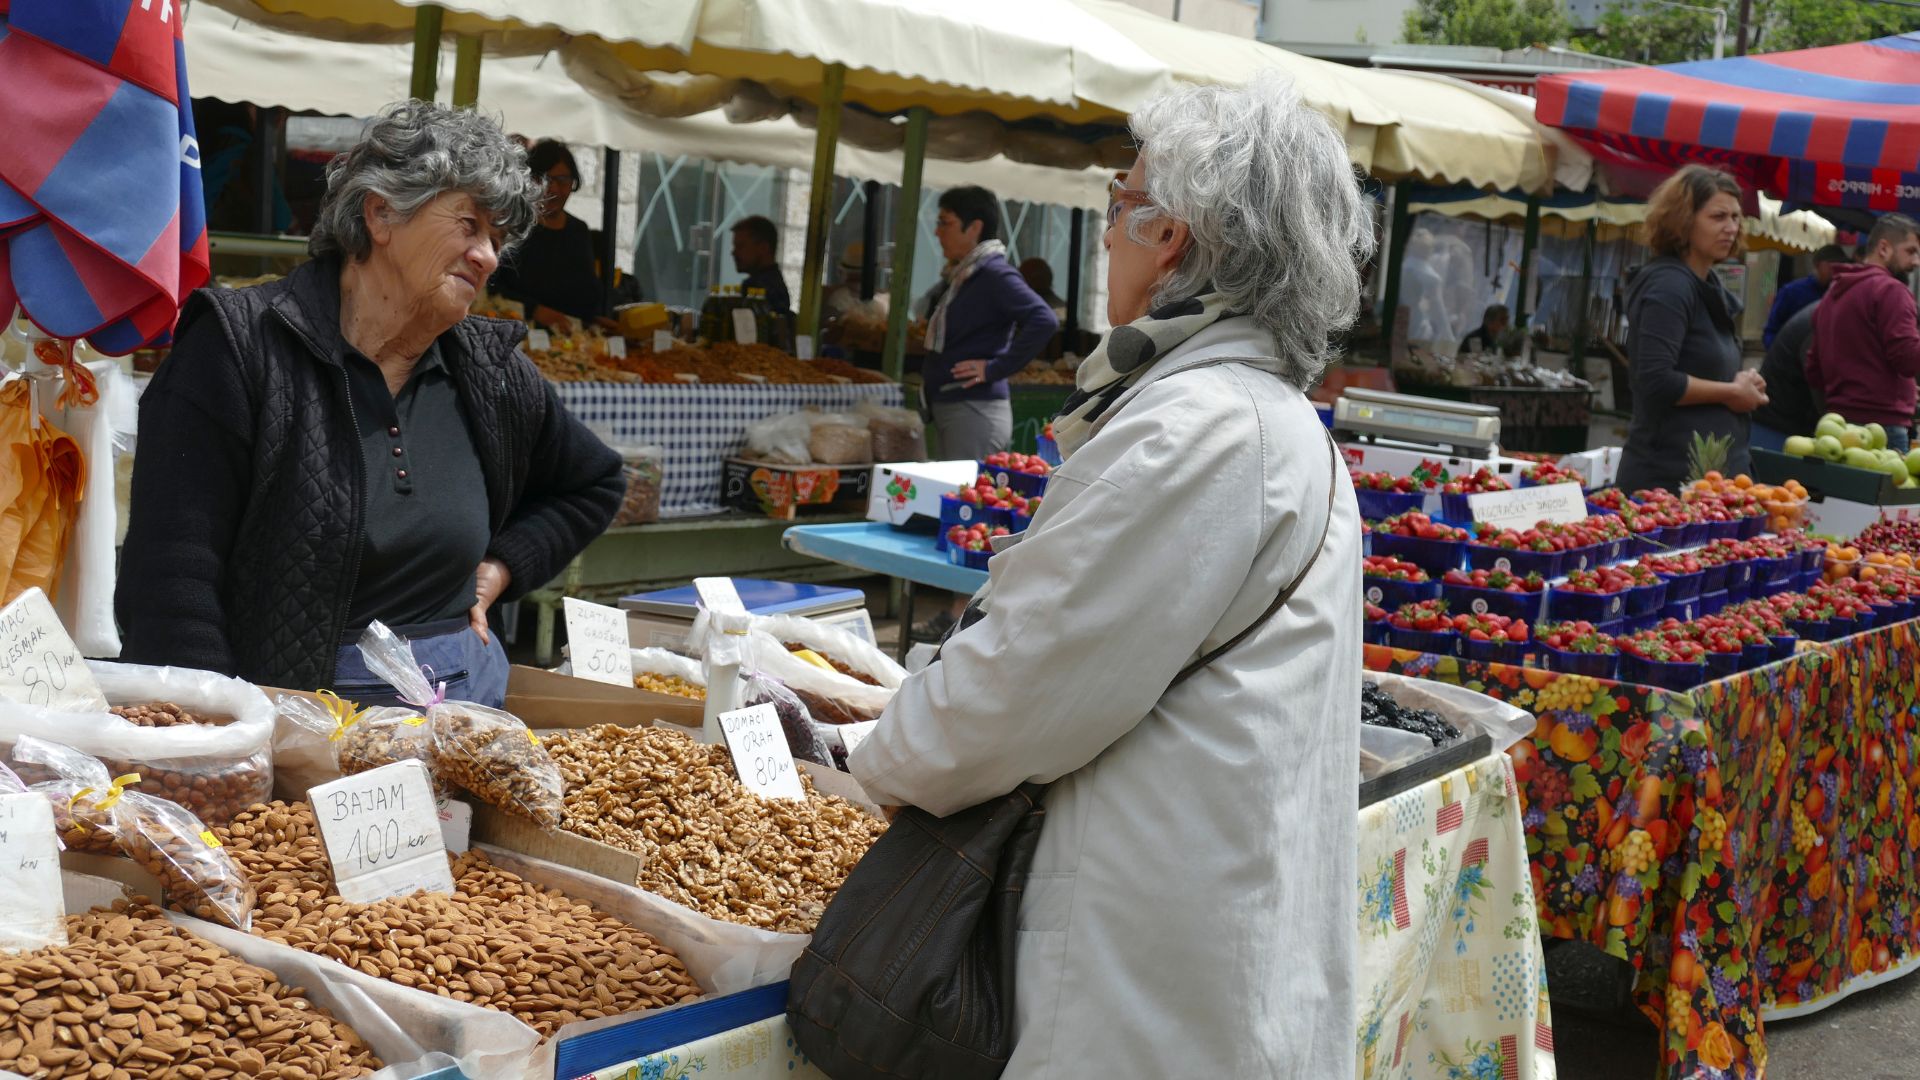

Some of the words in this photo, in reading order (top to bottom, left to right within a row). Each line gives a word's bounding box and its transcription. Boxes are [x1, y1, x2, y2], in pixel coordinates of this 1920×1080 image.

[588, 648, 617, 673] 50
[23, 651, 67, 708] 80
[742, 730, 773, 752] ORAH
[755, 756, 777, 786] 80
[328, 783, 405, 820] BAJAM
[346, 818, 399, 869] 100
